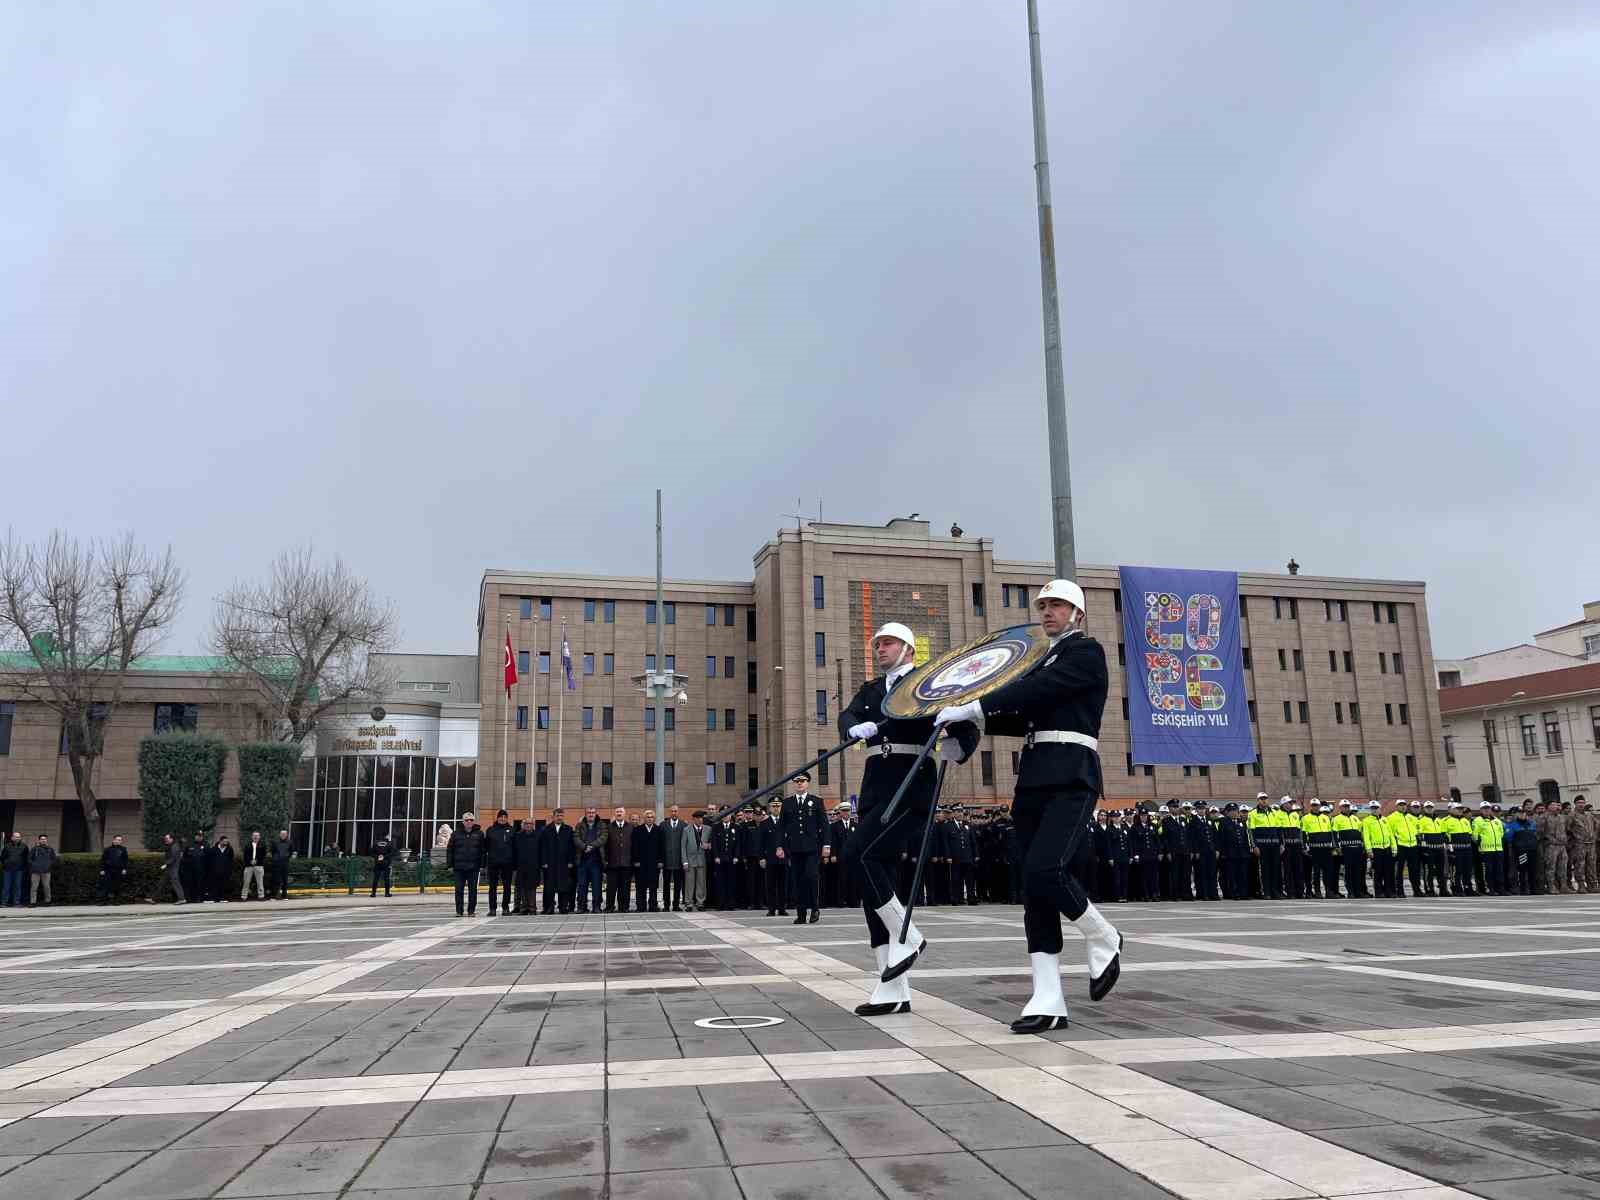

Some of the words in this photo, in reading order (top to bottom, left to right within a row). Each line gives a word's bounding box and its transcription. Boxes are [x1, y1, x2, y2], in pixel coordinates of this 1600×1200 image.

[1144, 592, 1221, 650] 20
[1151, 711, 1206, 728] ESKİŞEHİR
[1208, 713, 1229, 727] YILI
